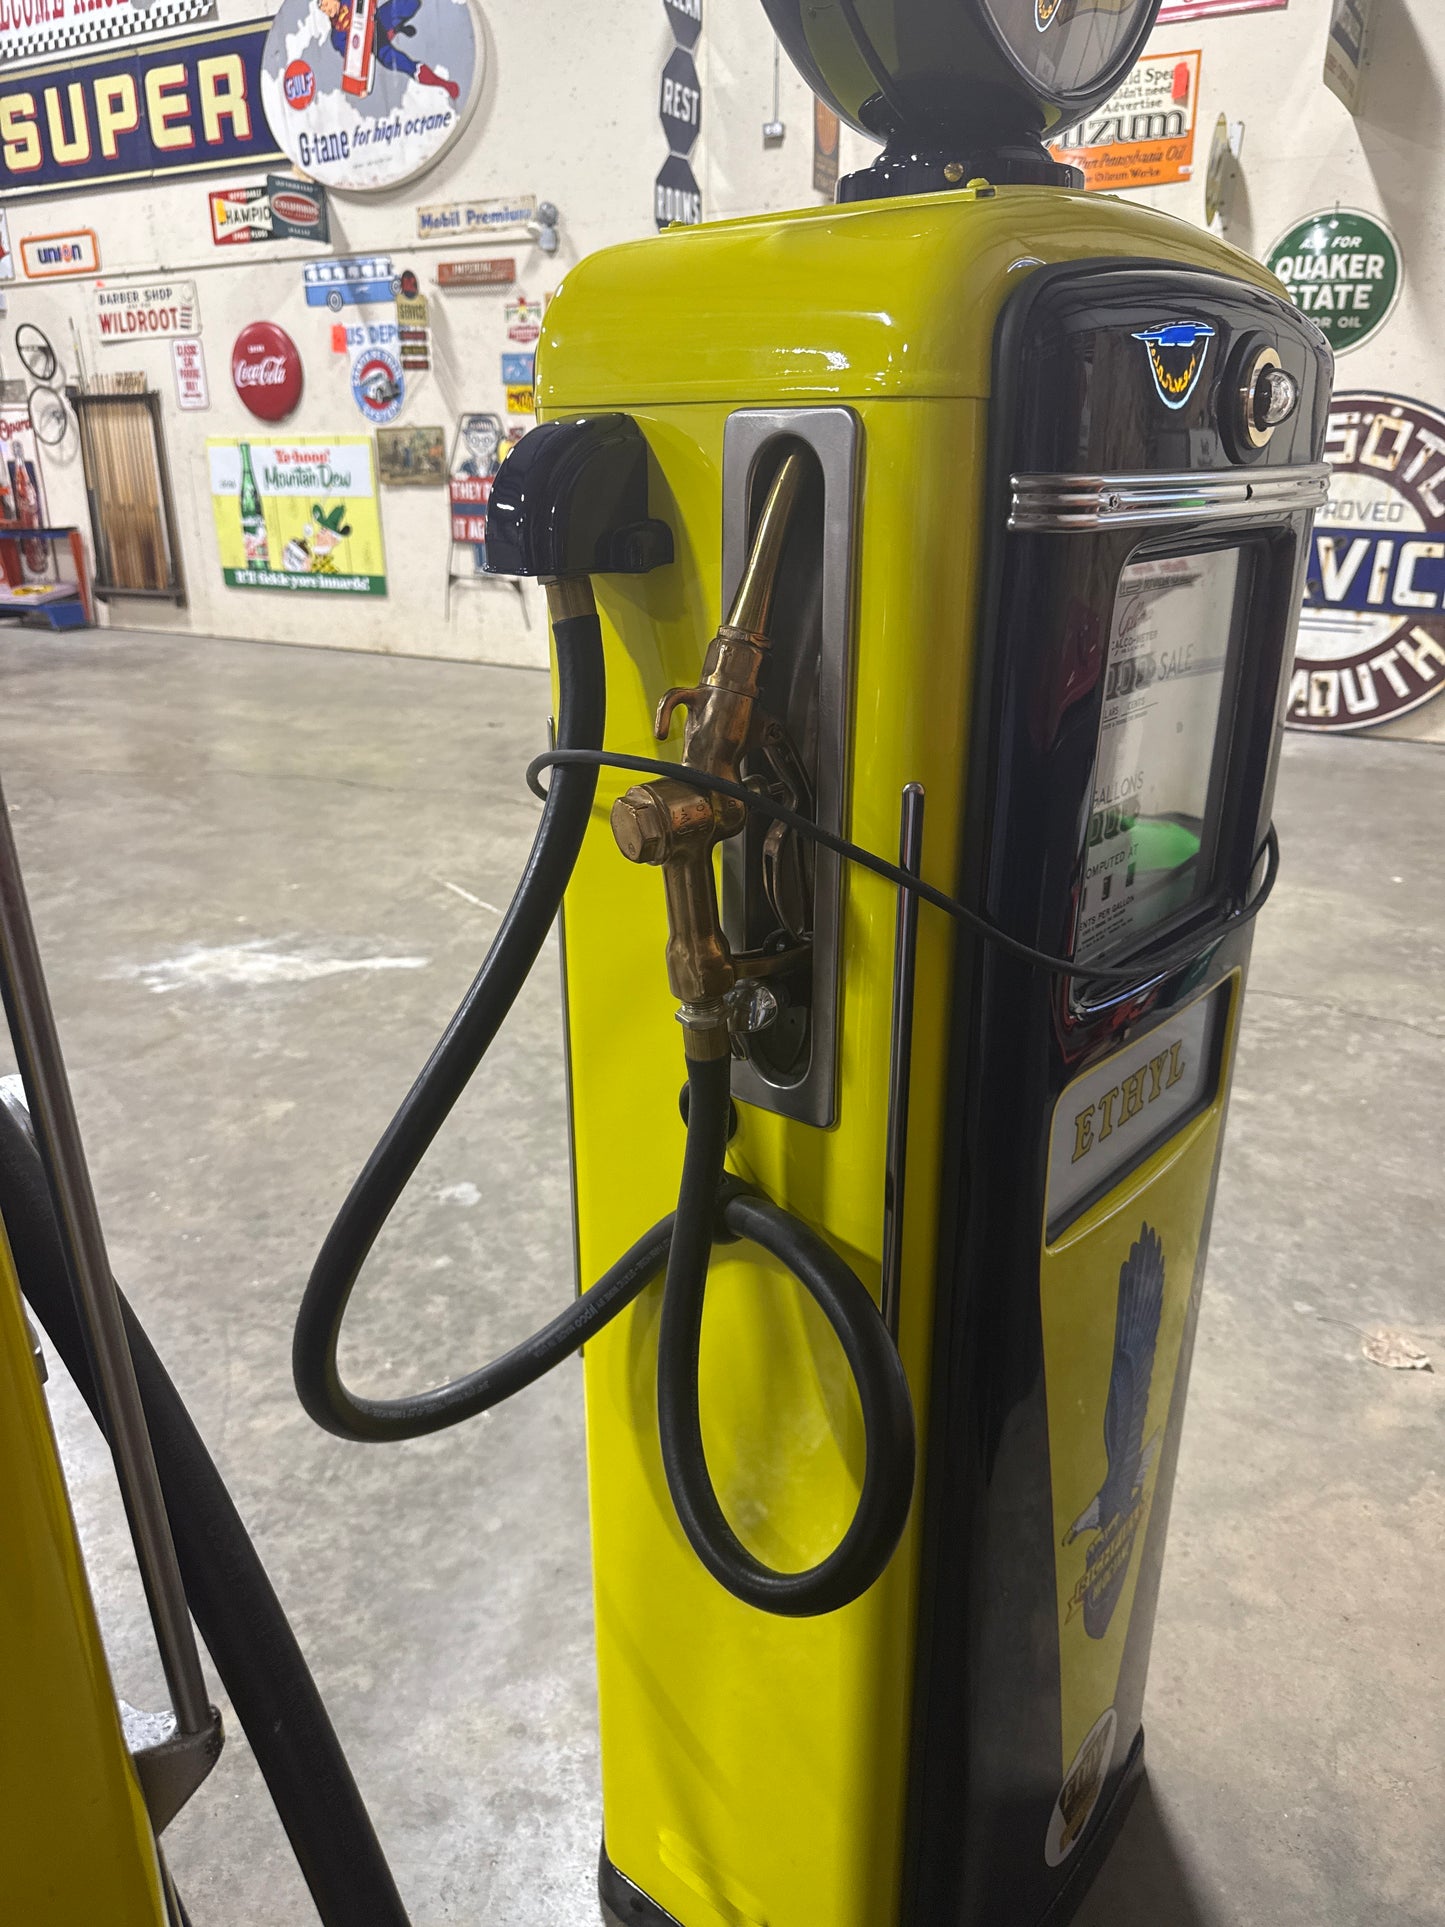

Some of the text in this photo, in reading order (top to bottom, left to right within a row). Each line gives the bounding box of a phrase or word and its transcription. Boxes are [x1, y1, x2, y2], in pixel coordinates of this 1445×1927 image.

[286, 71, 314, 99] GULF
[0, 53, 254, 174] SUPER
[662, 77, 699, 126] REST
[1102, 99, 1163, 115] Advertise
[299, 131, 350, 167] G-tane
[353, 126, 370, 148] for
[373, 120, 401, 146] high
[405, 111, 452, 138] octane
[1165, 144, 1186, 161] Oil
[220, 205, 271, 226] HAMPIO
[656, 183, 700, 224] ROOMS
[421, 206, 532, 229] Mobil Premium
[1331, 235, 1363, 249] FOR
[1274, 253, 1386, 285] QUAKER
[98, 287, 173, 306] BARBER SHOP
[1286, 284, 1374, 311] STATE
[98, 307, 178, 335] WILDROOT
[400, 305, 427, 321] SERVICE
[1337, 315, 1362, 329] OIL
[346, 322, 404, 345] US DEP
[264, 463, 352, 490] Mountain Dew
[451, 482, 481, 501] THEY
[1318, 499, 1405, 524] ROVED
[1302, 535, 1445, 609] VIC
[1158, 642, 1195, 681] SALE
[1086, 850, 1126, 880] OMPUTED
[1079, 915, 1096, 931] ENTS
[1071, 1040, 1186, 1164] ETHYL
